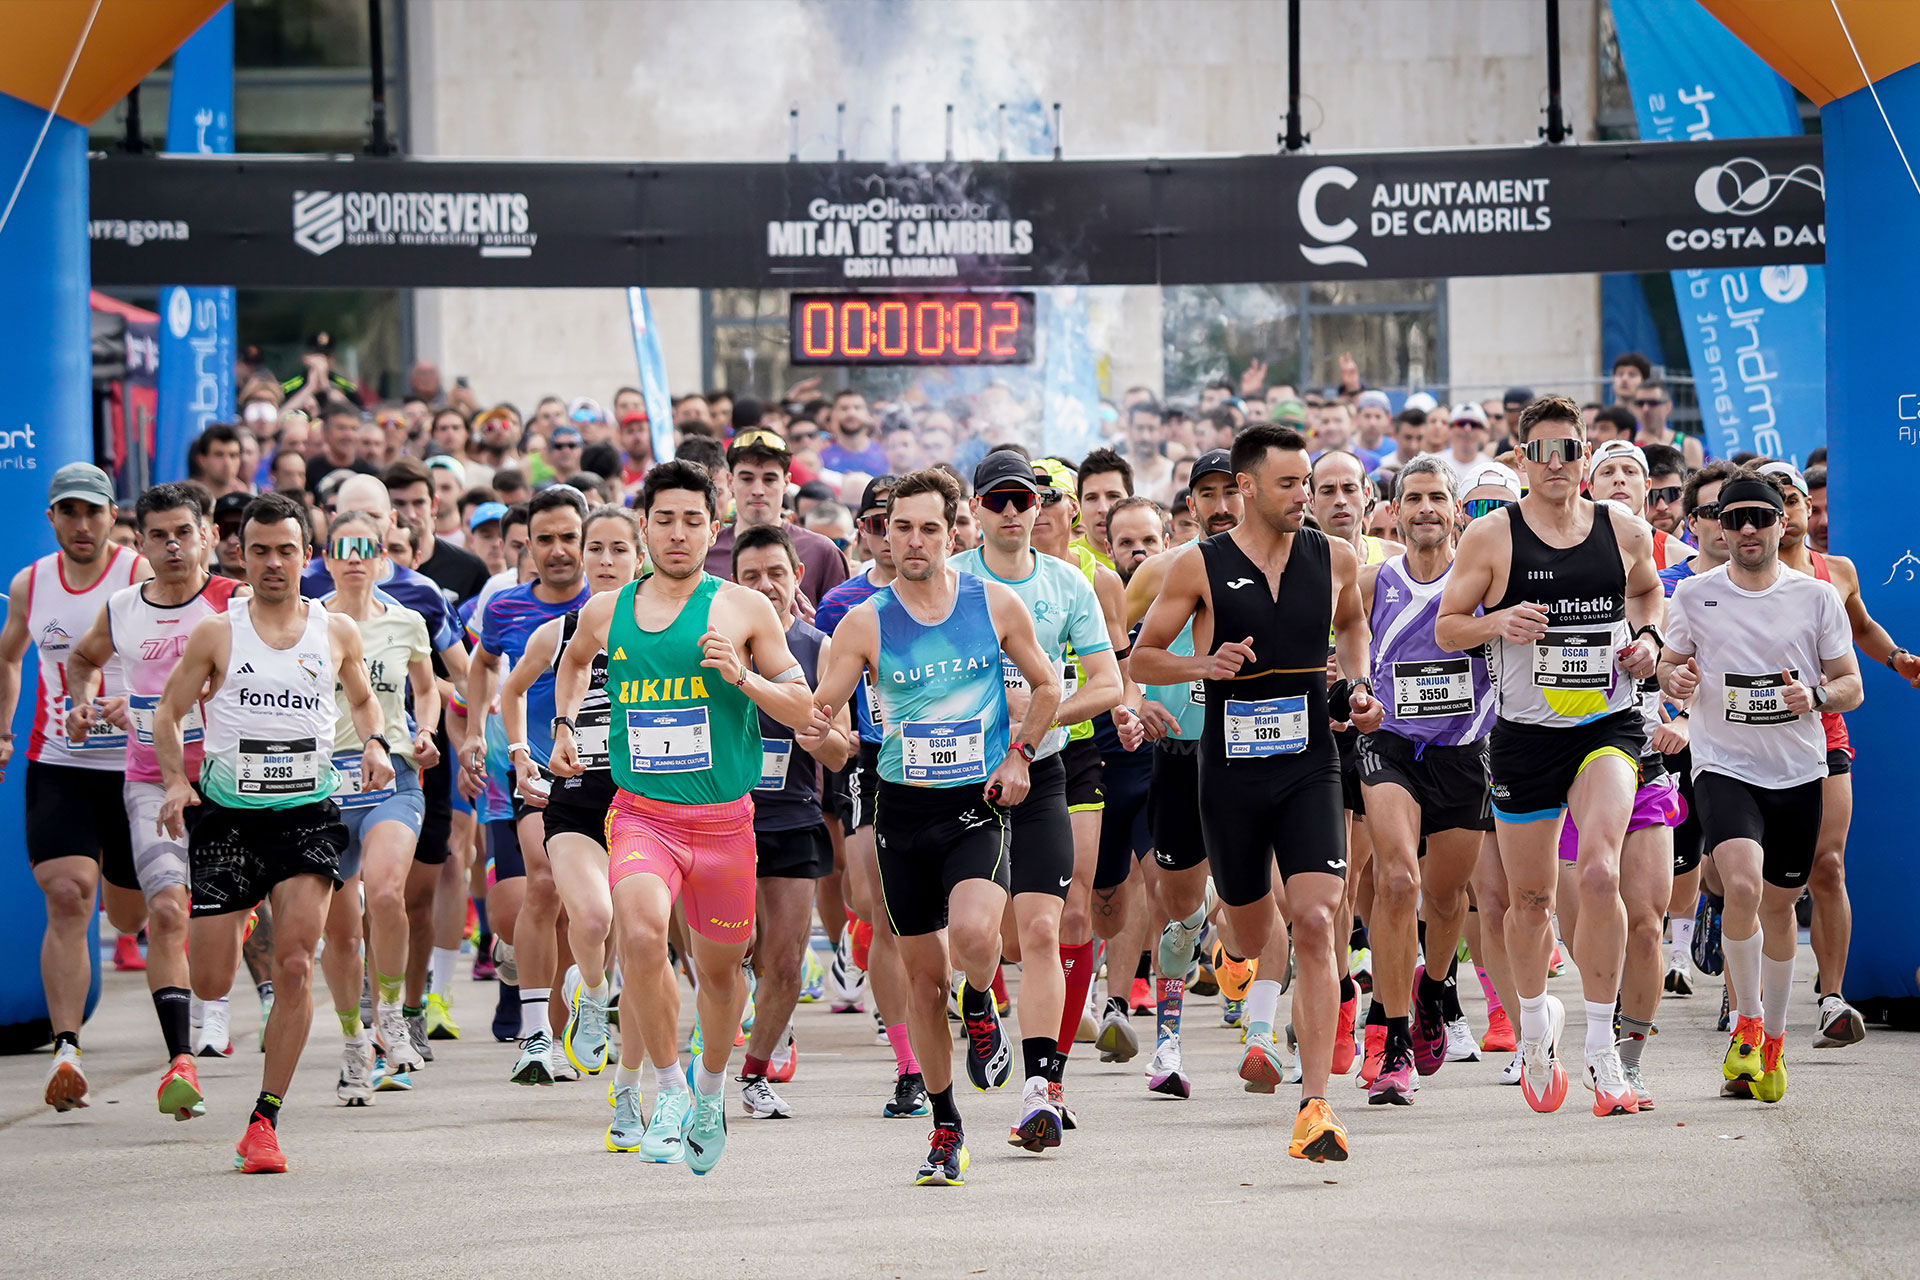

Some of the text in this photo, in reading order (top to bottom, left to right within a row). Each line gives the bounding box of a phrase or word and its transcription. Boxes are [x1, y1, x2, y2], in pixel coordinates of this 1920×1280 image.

[1371, 178, 1550, 208] AJUNTAMENT
[345, 191, 529, 234] SPORTSEVENTS
[1371, 206, 1552, 237] DE CAMBRILS
[346, 232, 538, 246] sports marketing agency
[767, 219, 1034, 257] MITJA DE CAMBRILS
[1665, 226, 1767, 251] COSTA
[843, 257, 958, 278] COSTA DAURADA
[803, 301, 1019, 357] 00:00:02
[1527, 570, 1554, 580] GOBIK
[893, 655, 990, 684] QUETZAL
[1561, 660, 1588, 673] 3113
[1416, 676, 1450, 687] SANJUAN
[618, 676, 710, 704] BIKILA
[1419, 687, 1449, 701] 3550
[1750, 688, 1776, 698] EDGAR
[239, 687, 320, 711] fondavi
[1748, 699, 1777, 711] 3548
[1254, 715, 1279, 726] Marin
[1254, 727, 1281, 740] 1376
[663, 741, 671, 754] 7
[929, 738, 957, 748] OSCAR
[263, 755, 294, 764] Alberto
[930, 750, 957, 764] 1201
[263, 766, 293, 779] 3293
